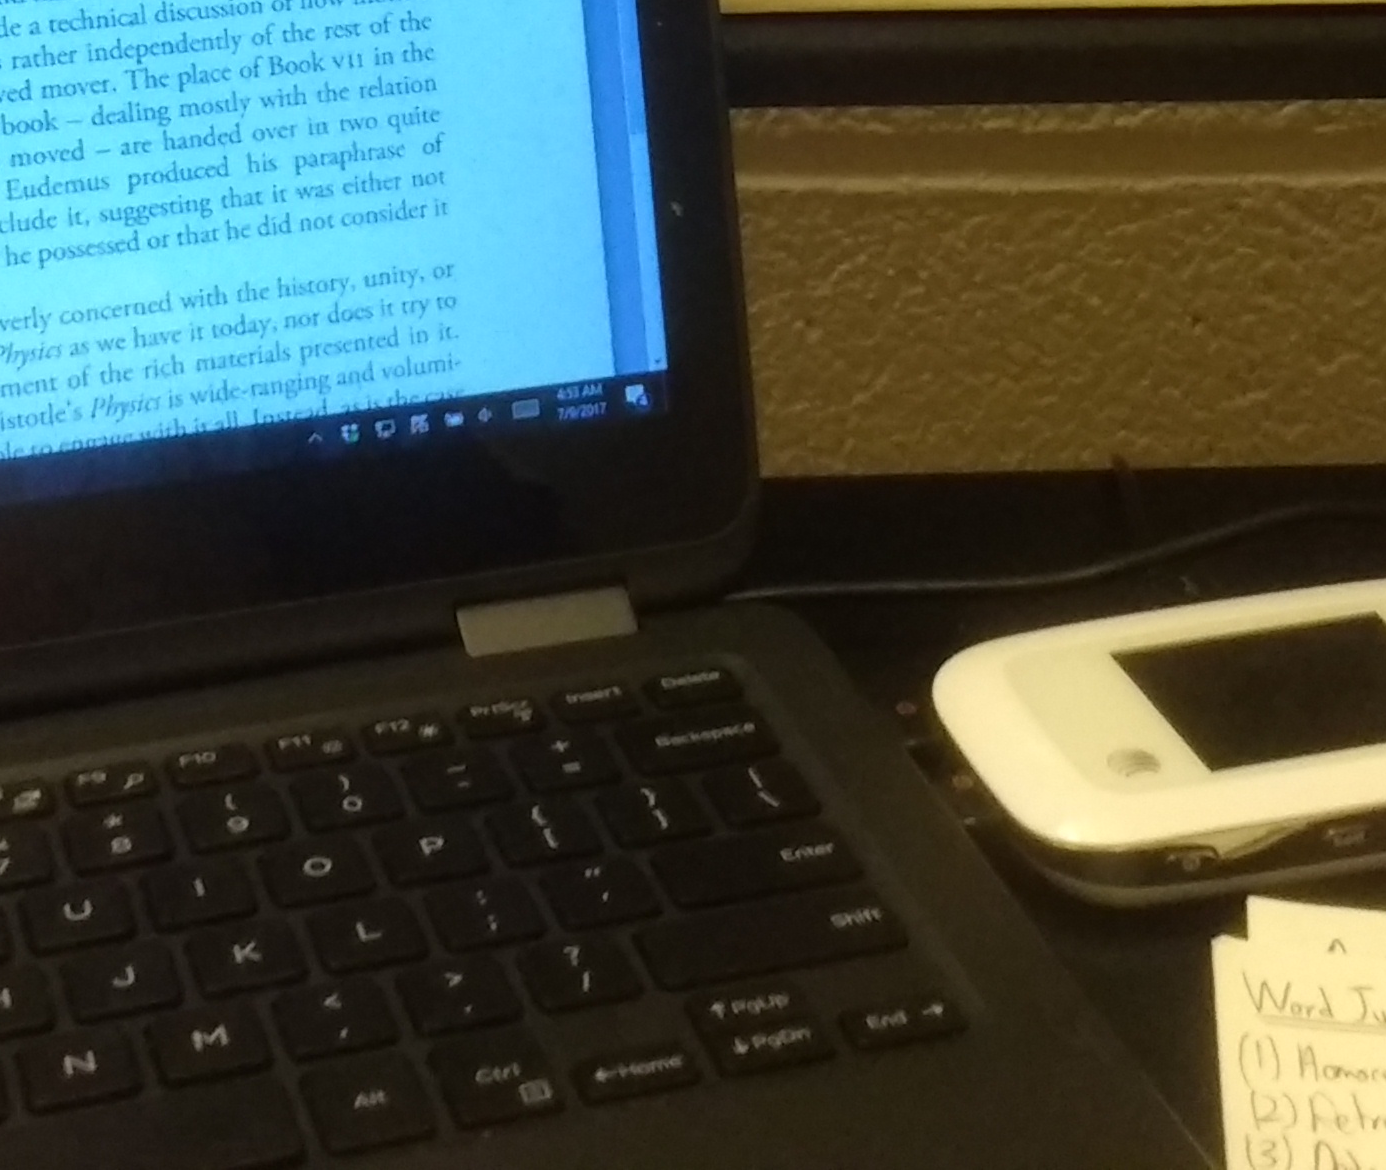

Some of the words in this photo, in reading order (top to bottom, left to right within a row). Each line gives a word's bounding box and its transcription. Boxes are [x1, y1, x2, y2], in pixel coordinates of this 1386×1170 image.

[89, 392, 162, 423] Physics
[191, 371, 331, 407] wide-ranging
[337, 363, 375, 387] and
[380, 356, 463, 381] volumi-
[654, 720, 756, 748] Backspace
[780, 839, 835, 863] Enter
[830, 905, 883, 929] Shift
[1242, 971, 1335, 1019] Word
[866, 1009, 907, 1031] End
[618, 1054, 683, 1080] Home
[353, 1088, 387, 1111] Alt
